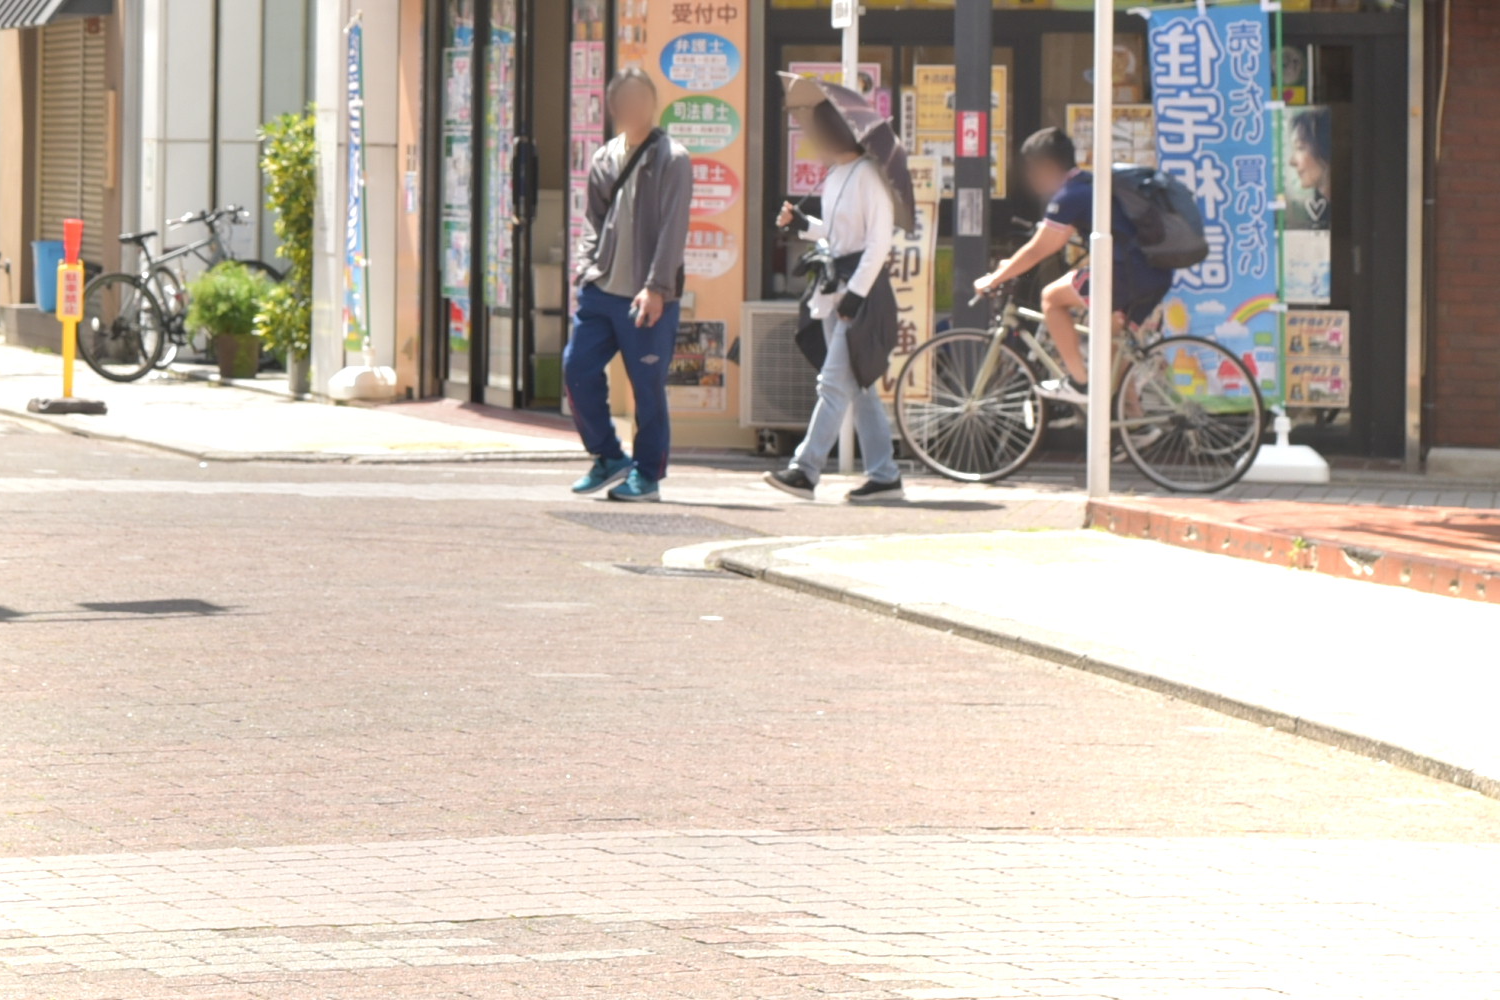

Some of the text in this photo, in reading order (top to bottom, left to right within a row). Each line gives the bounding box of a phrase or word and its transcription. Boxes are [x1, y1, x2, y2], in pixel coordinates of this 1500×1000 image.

[672, 3, 738, 24] 受付中
[674, 38, 725, 54] 弁護士
[673, 102, 729, 121] 司法書士
